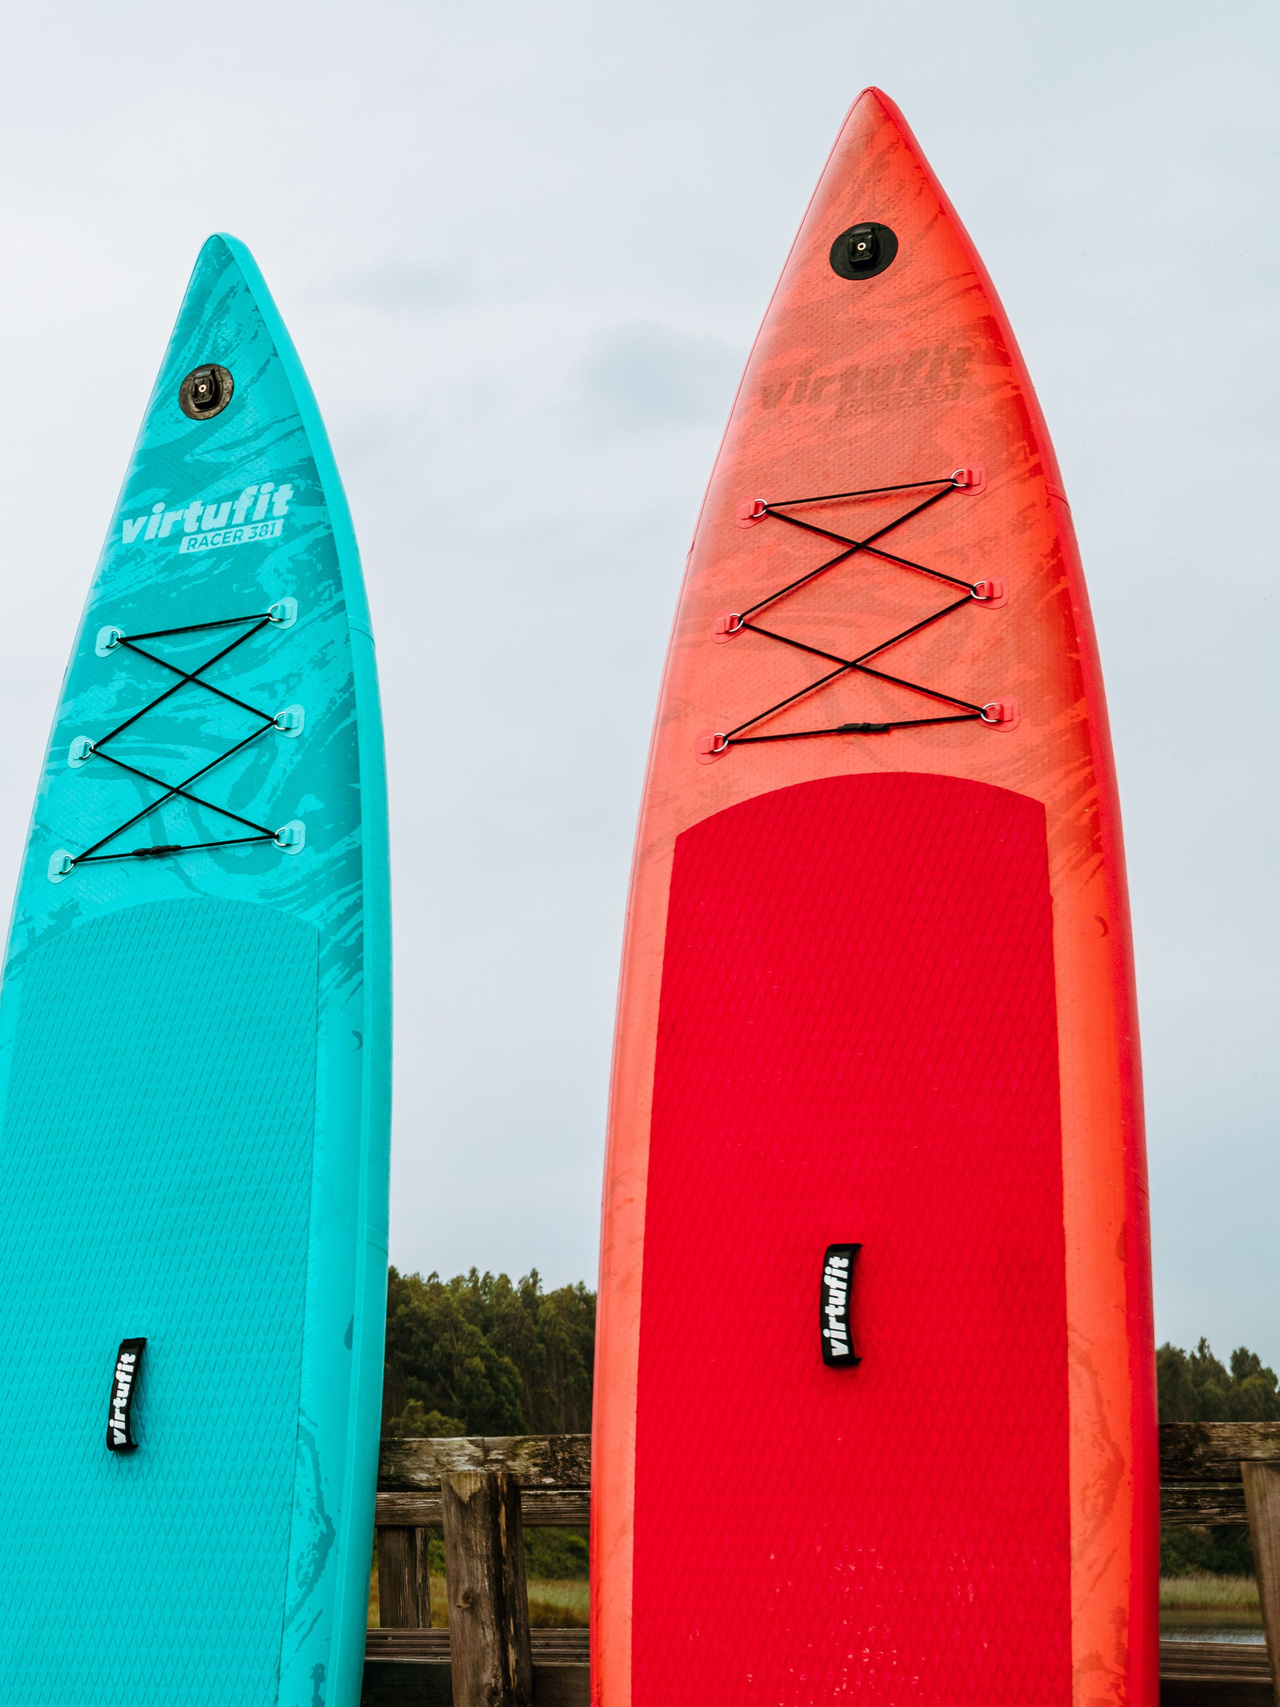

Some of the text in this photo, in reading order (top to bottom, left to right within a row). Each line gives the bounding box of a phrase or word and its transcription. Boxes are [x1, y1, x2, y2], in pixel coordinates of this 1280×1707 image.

[760, 344, 974, 411] virtufit
[122, 482, 294, 544] virtufit
[186, 522, 276, 551] RACER 381
[823, 1256, 849, 1356] virtufit
[108, 1353, 136, 1445] virtufit
